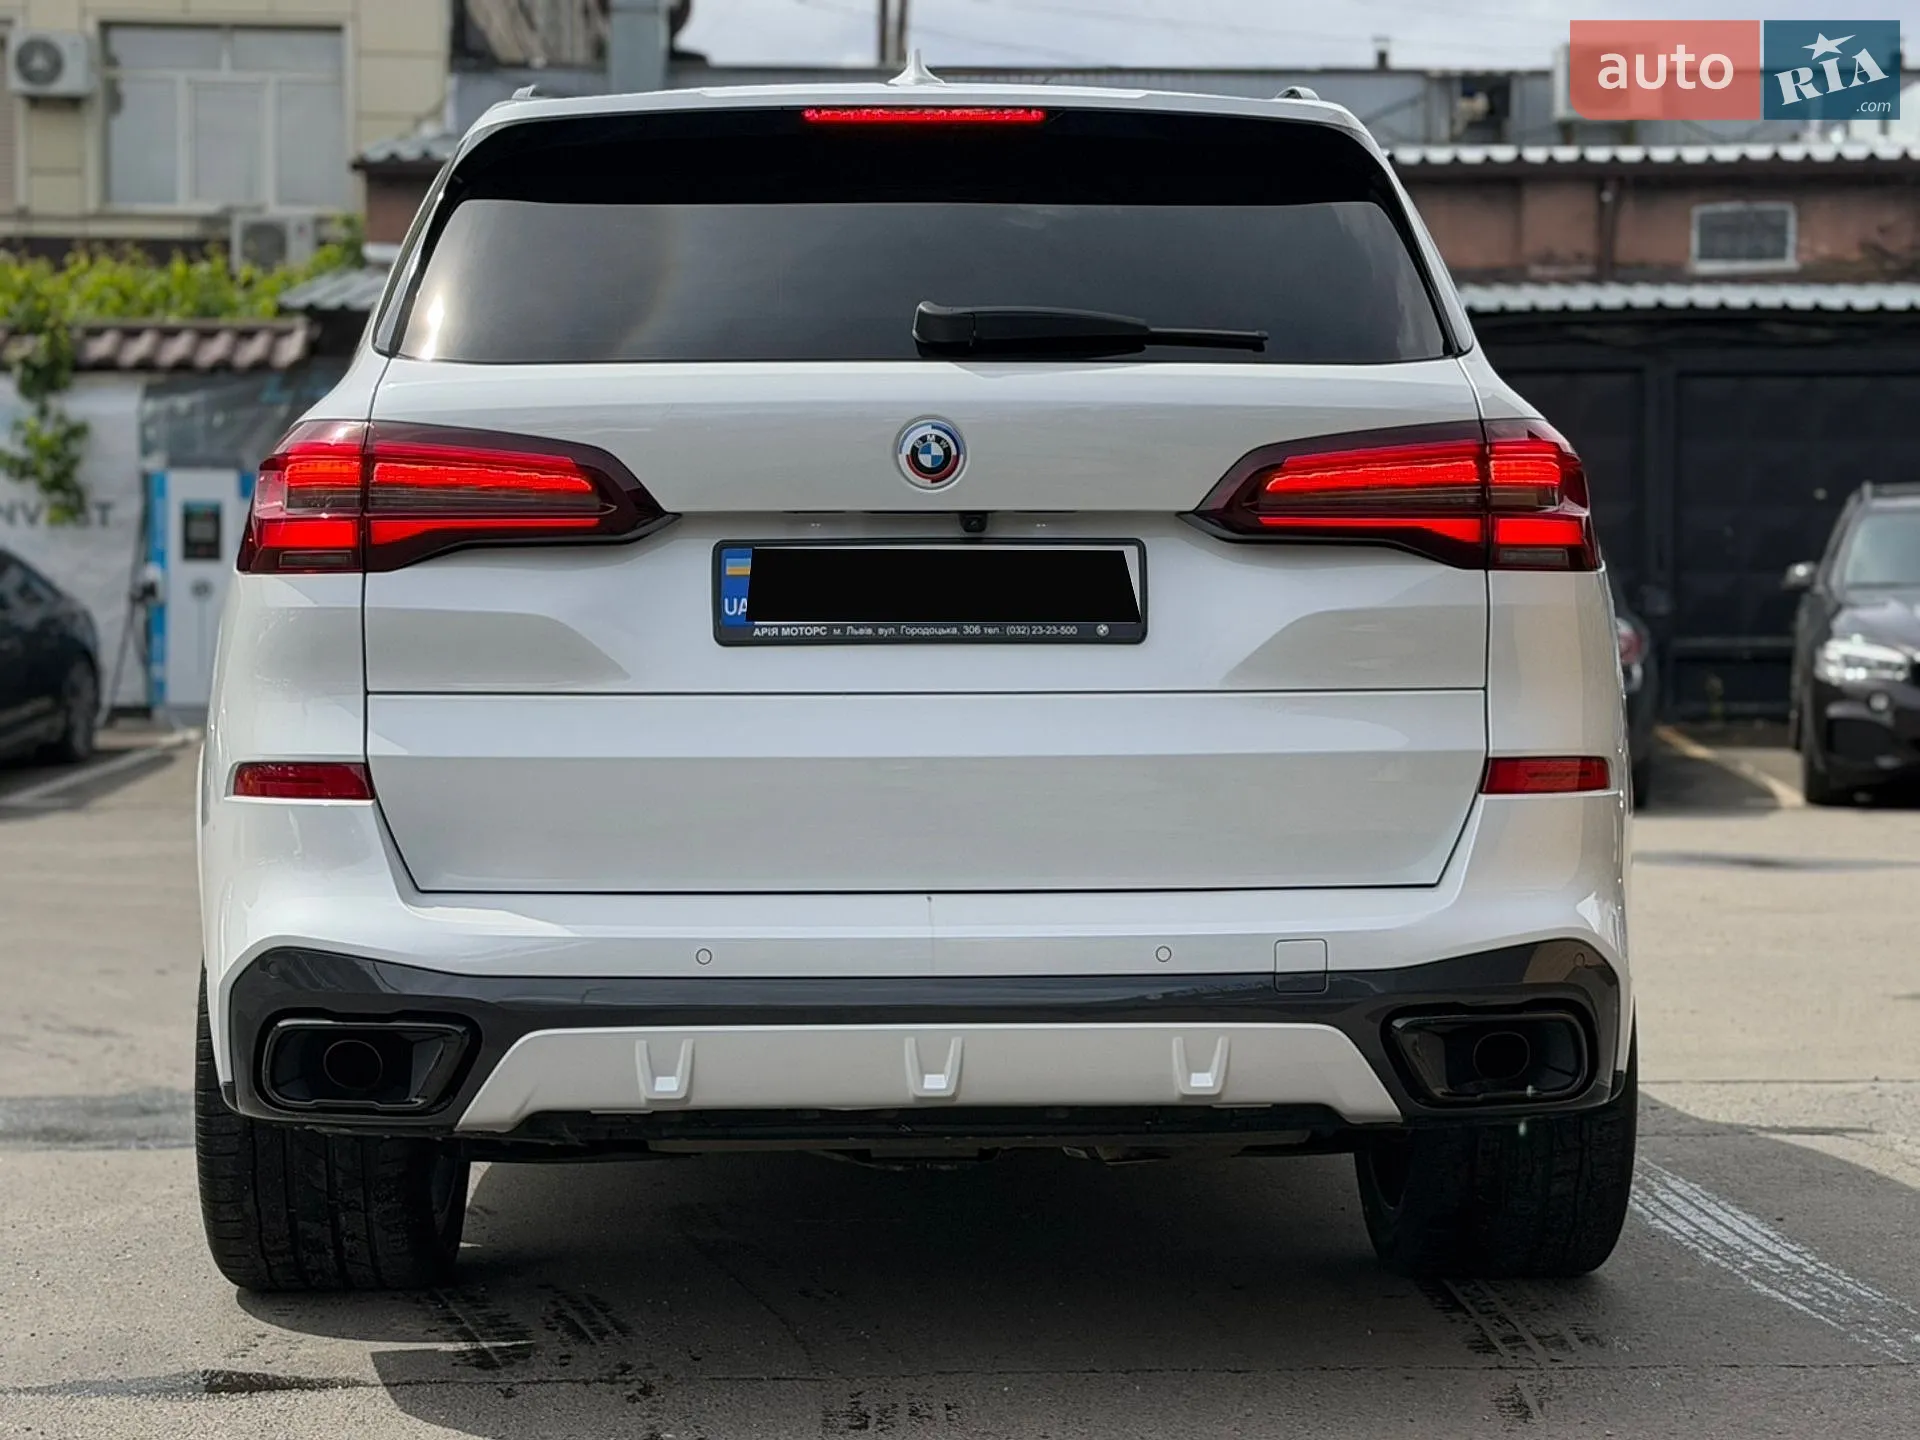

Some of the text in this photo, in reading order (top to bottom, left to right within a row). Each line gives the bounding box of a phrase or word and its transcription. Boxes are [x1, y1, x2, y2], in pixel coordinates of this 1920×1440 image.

[914, 433, 949, 449] BMW
[724, 597, 748, 616] UA
[753, 626, 779, 637] АРІЯ
[781, 626, 828, 637] МОТОРС
[899, 625, 961, 637] Городоцька,
[962, 625, 981, 635] 306
[1006, 625, 1030, 636] (032)
[1031, 625, 1078, 635] 23-23-500
